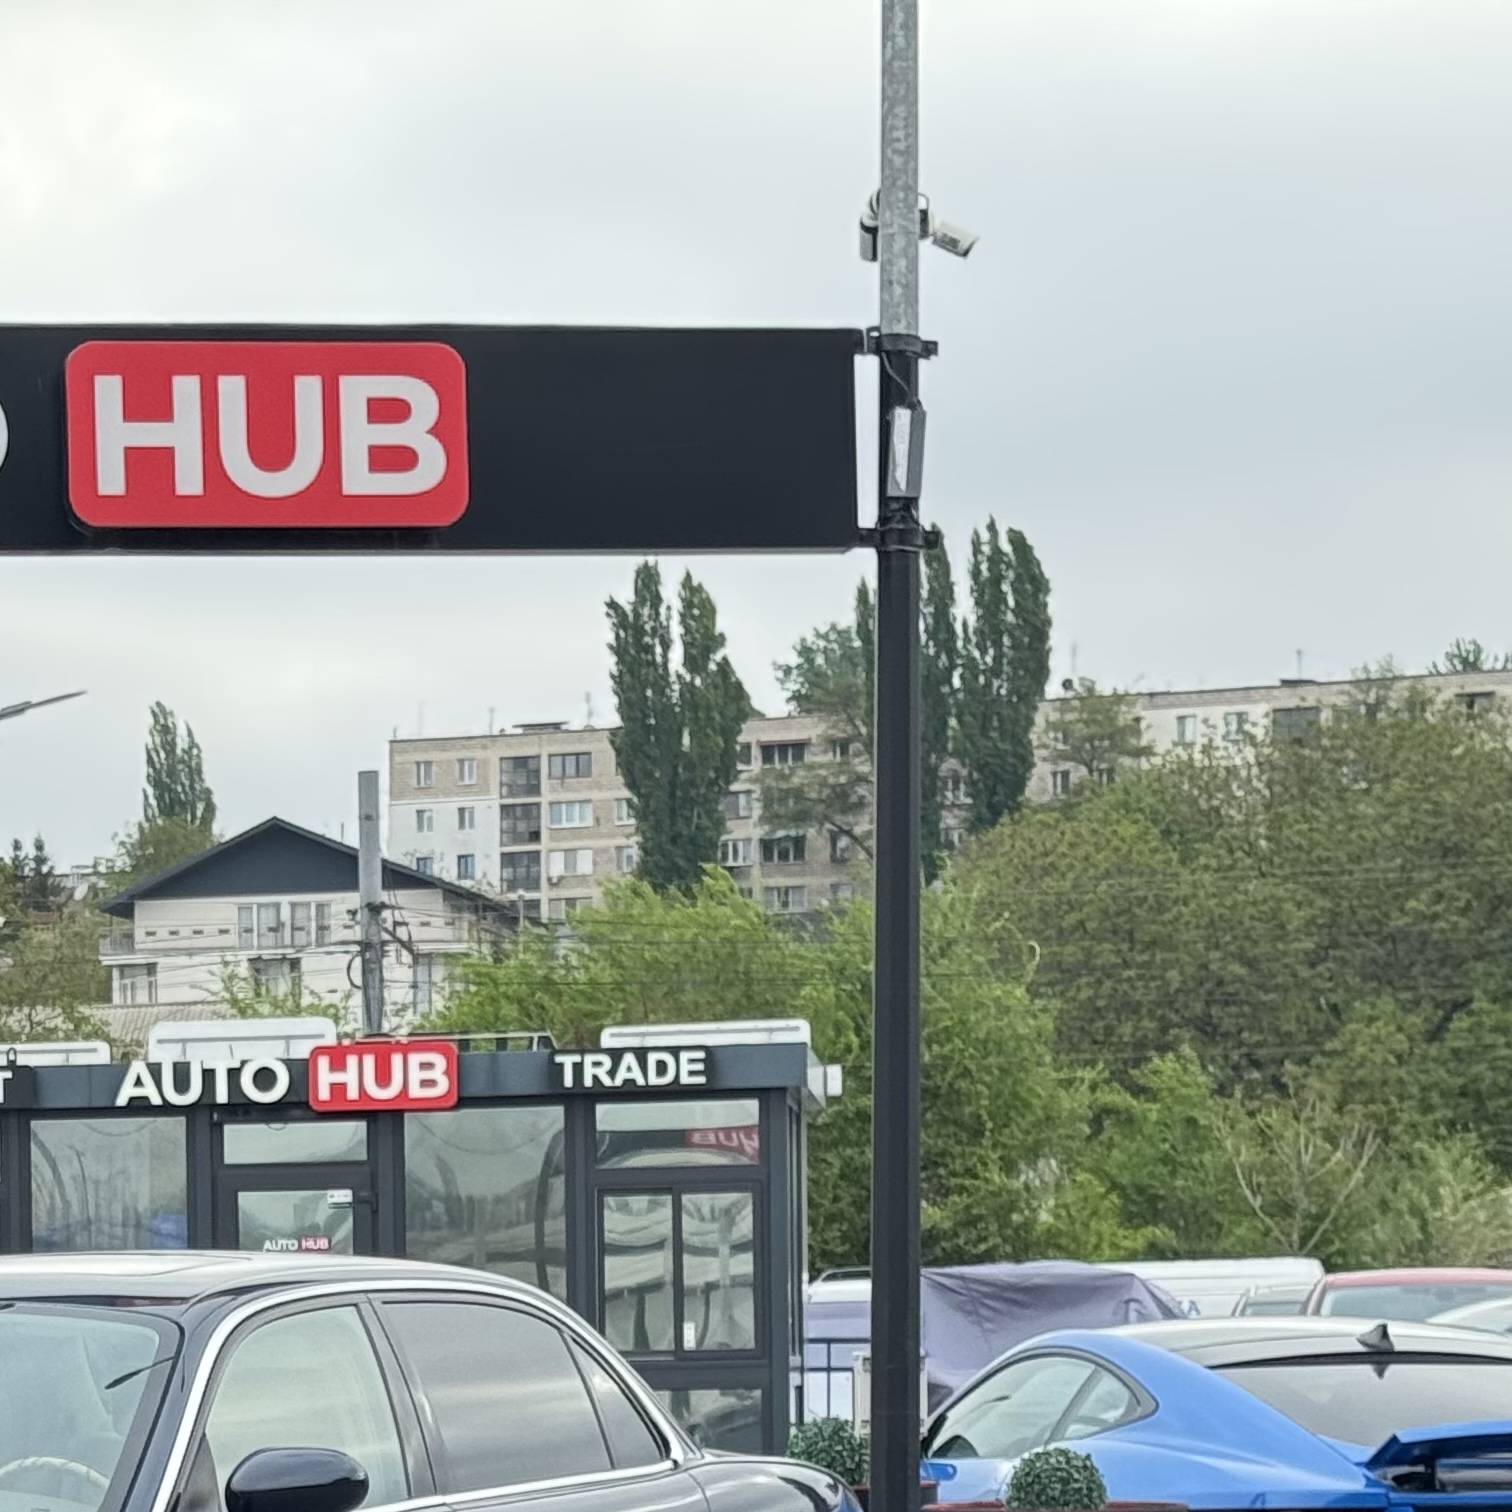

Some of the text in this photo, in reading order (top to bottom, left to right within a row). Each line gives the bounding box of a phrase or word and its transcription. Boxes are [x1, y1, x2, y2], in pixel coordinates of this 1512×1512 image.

[93, 374, 447, 497] HUB
[114, 1053, 451, 1107] AUTO HUB
[554, 1050, 707, 1088] TRADE
[263, 1237, 329, 1252] AUTO HUB
